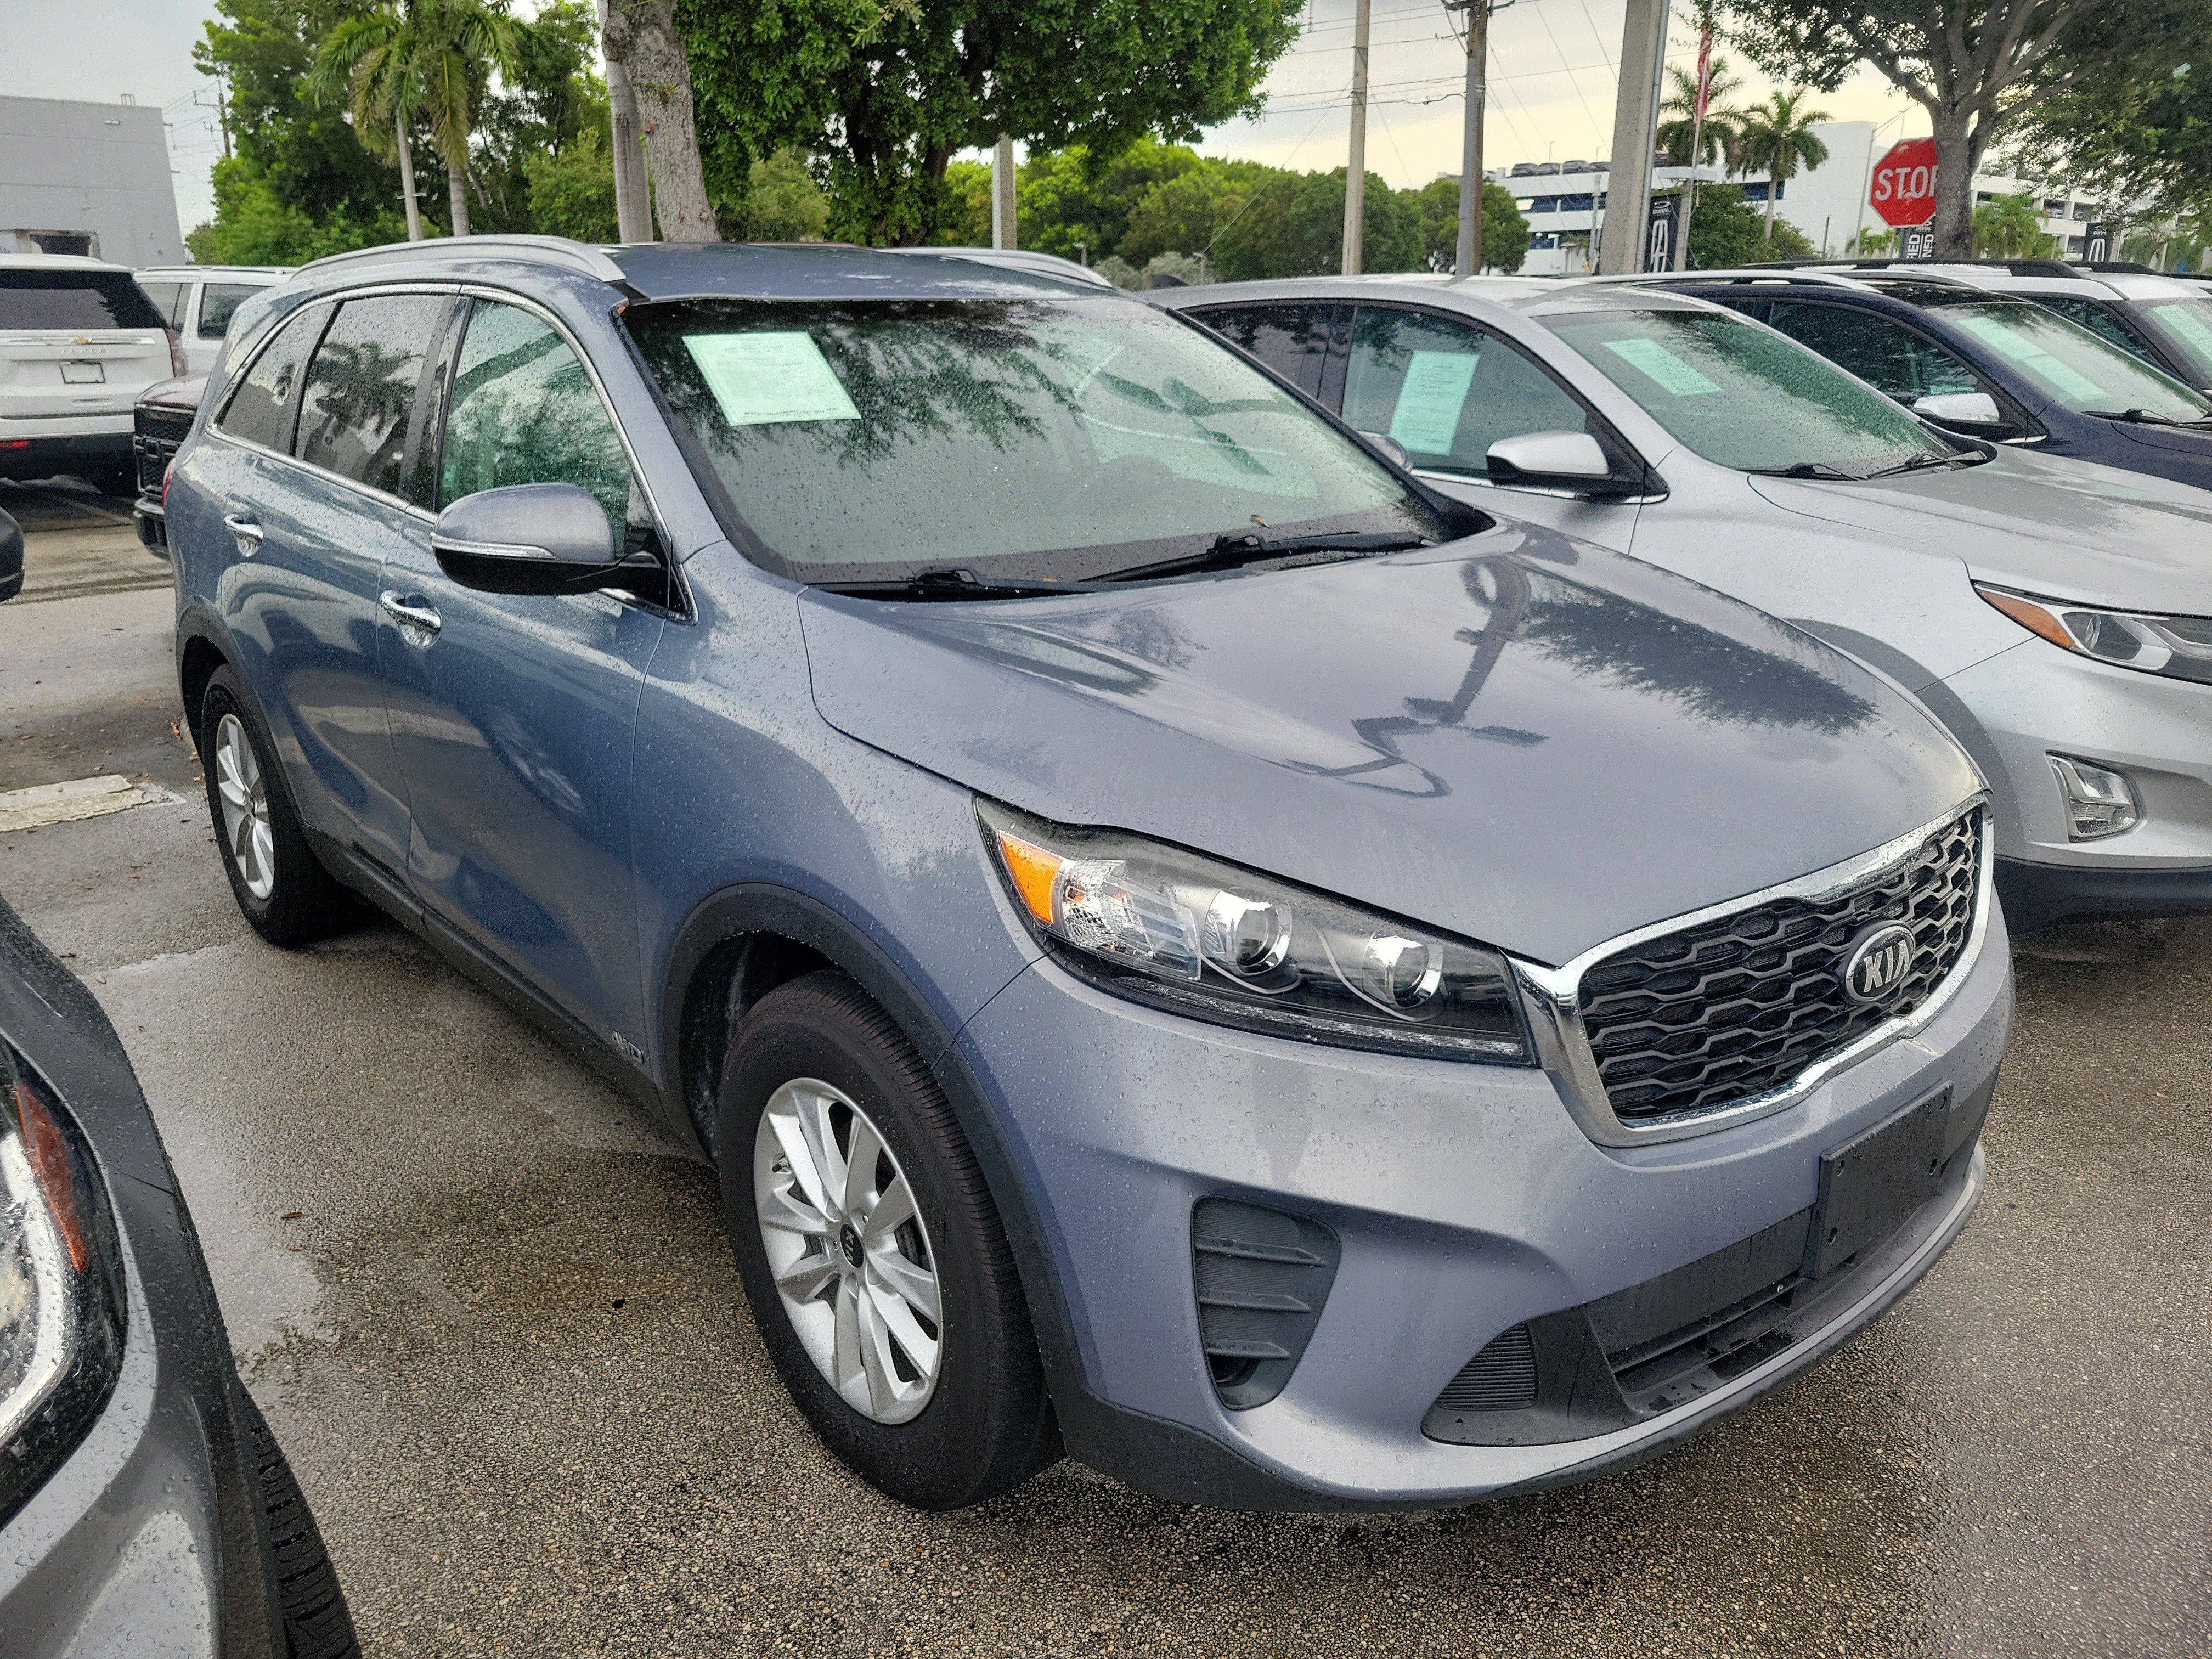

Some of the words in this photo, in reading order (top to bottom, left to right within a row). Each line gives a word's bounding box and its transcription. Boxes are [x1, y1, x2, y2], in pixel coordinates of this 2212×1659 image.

[1906, 234, 1920, 258] IED
[1863, 939, 1909, 992] KIA
[845, 1229, 854, 1261] KIA
